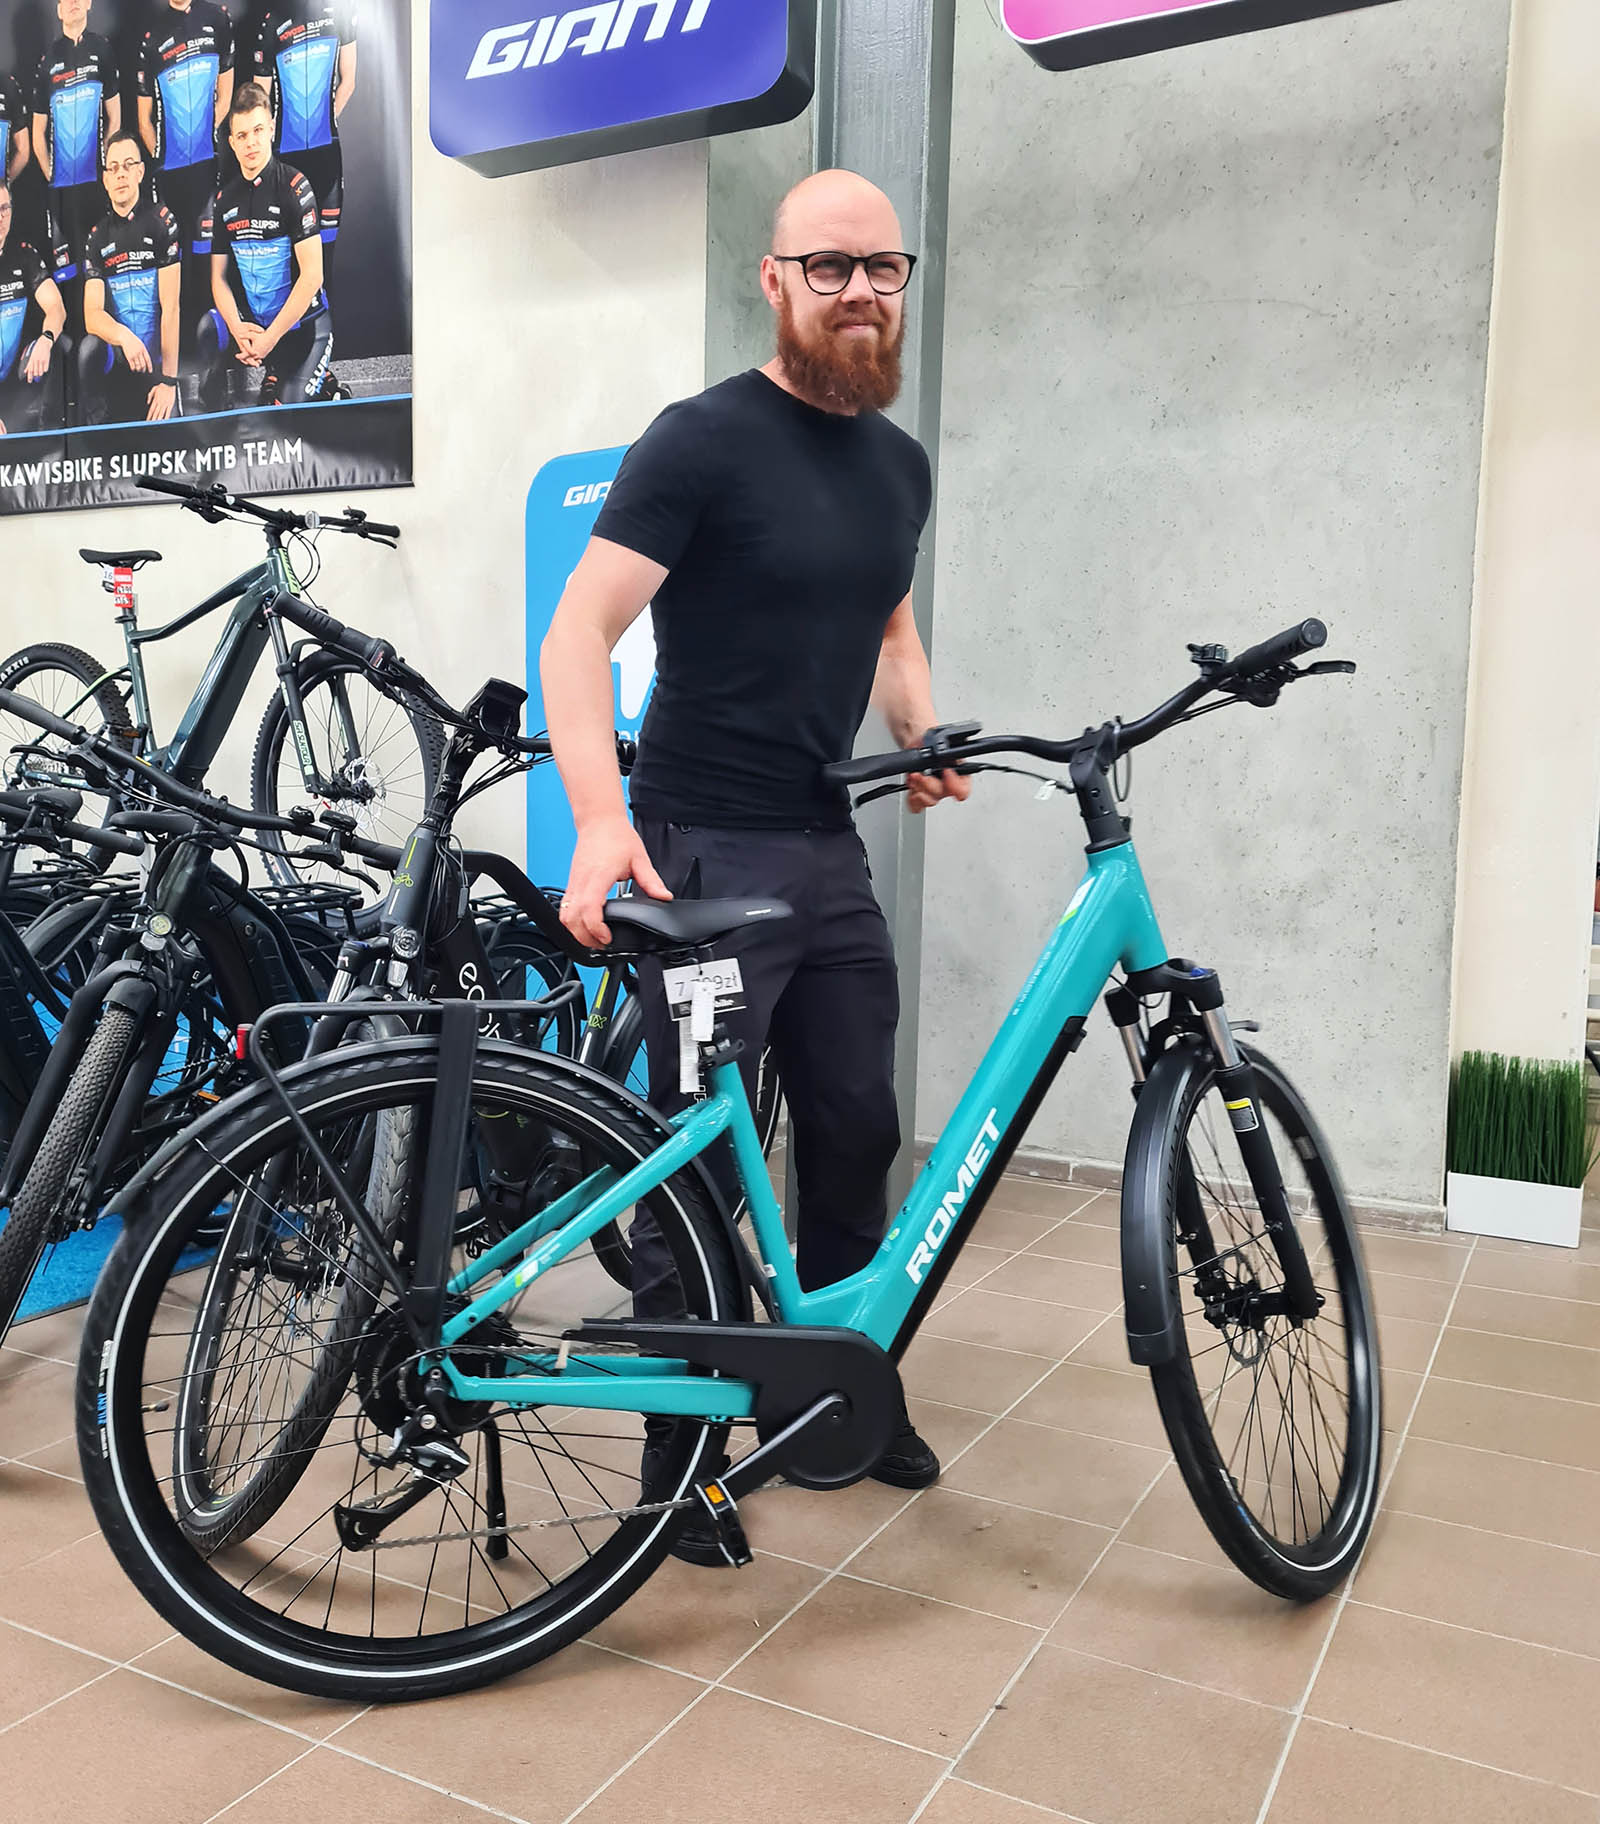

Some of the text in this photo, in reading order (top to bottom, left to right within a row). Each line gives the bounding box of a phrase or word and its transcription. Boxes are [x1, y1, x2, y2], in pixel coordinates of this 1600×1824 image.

[0, 437, 303, 487] KAWISBIKE SLUPSK MTB TEAM
[562, 480, 614, 508] GIA
[0, 656, 30, 685] AXXIS
[905, 1107, 1000, 1284] ROMET
